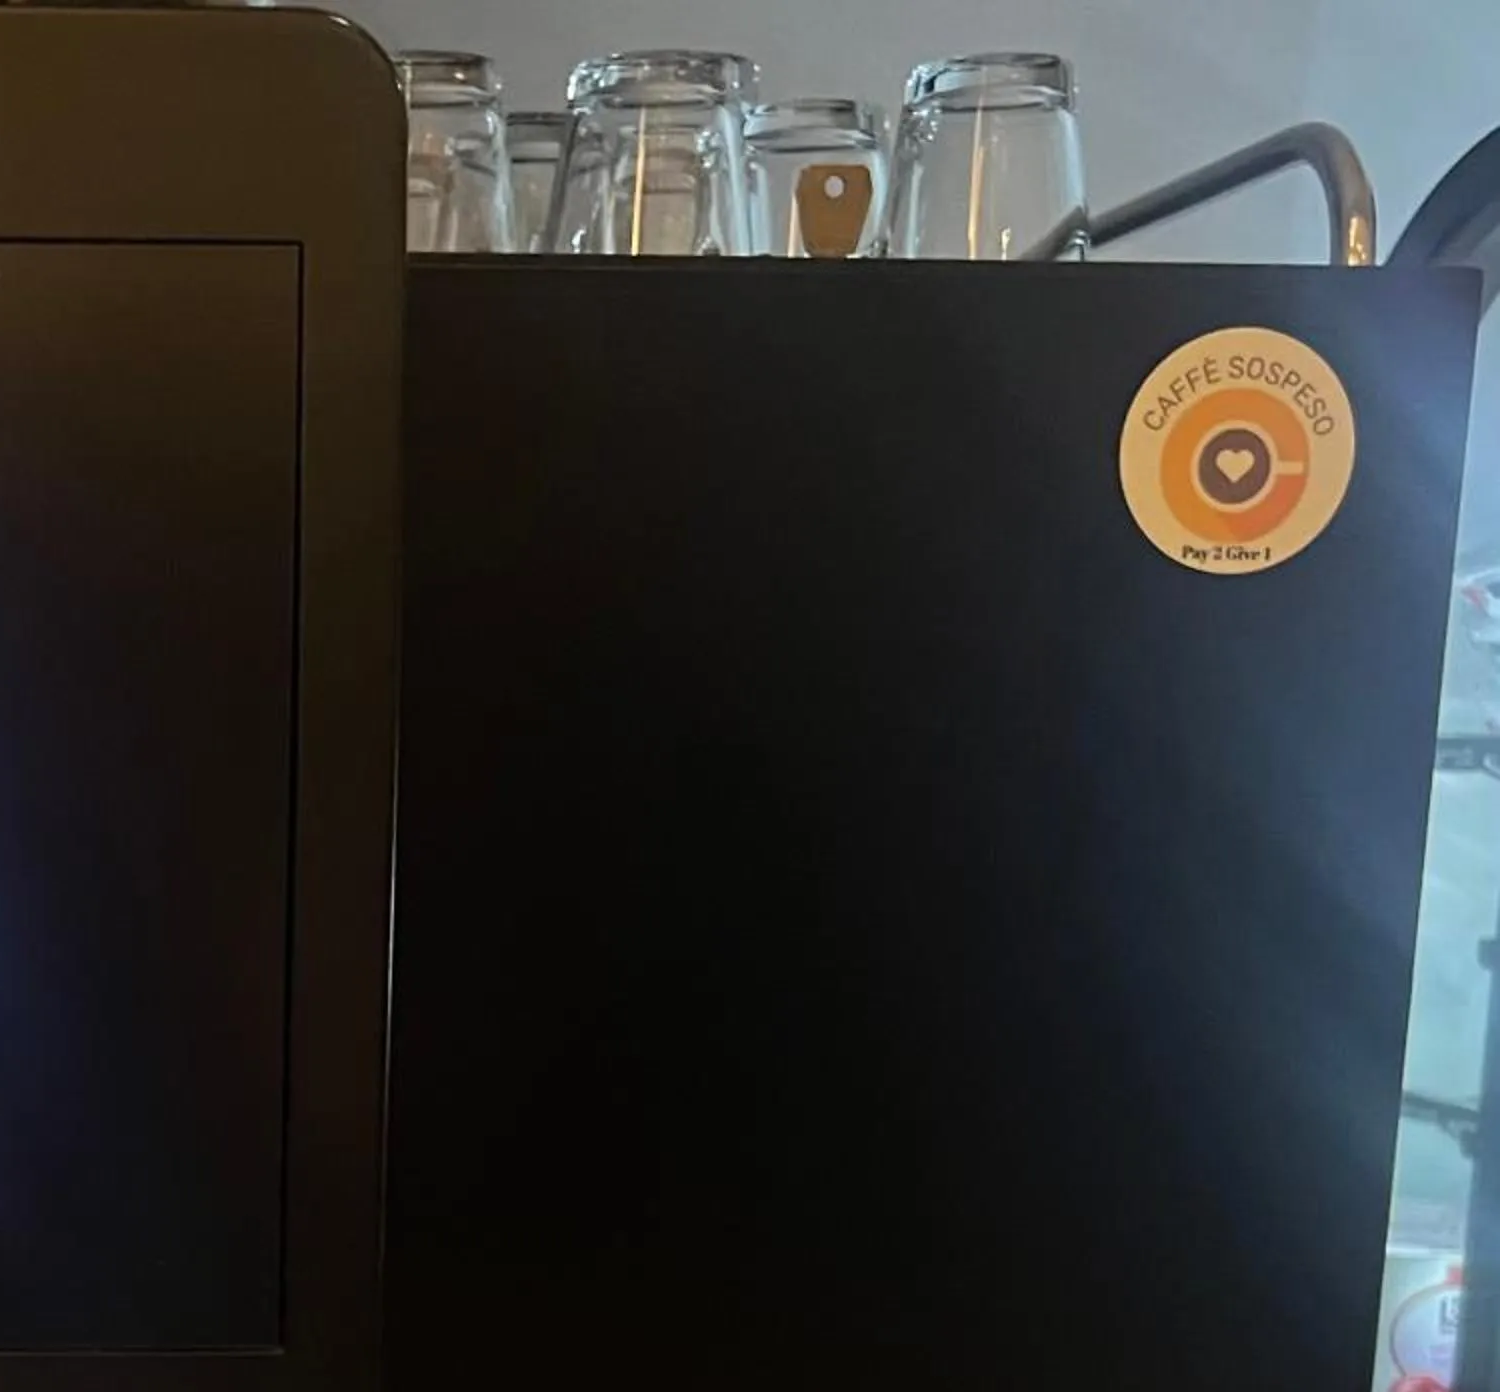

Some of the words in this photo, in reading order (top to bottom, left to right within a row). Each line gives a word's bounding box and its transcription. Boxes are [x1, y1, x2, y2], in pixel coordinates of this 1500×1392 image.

[1143, 357, 1222, 431] CAFFÈ
[1228, 356, 1335, 437] SOSPESO
[1182, 545, 1207, 564] Pay
[1213, 546, 1223, 560] 2
[1226, 545, 1260, 561] Give
